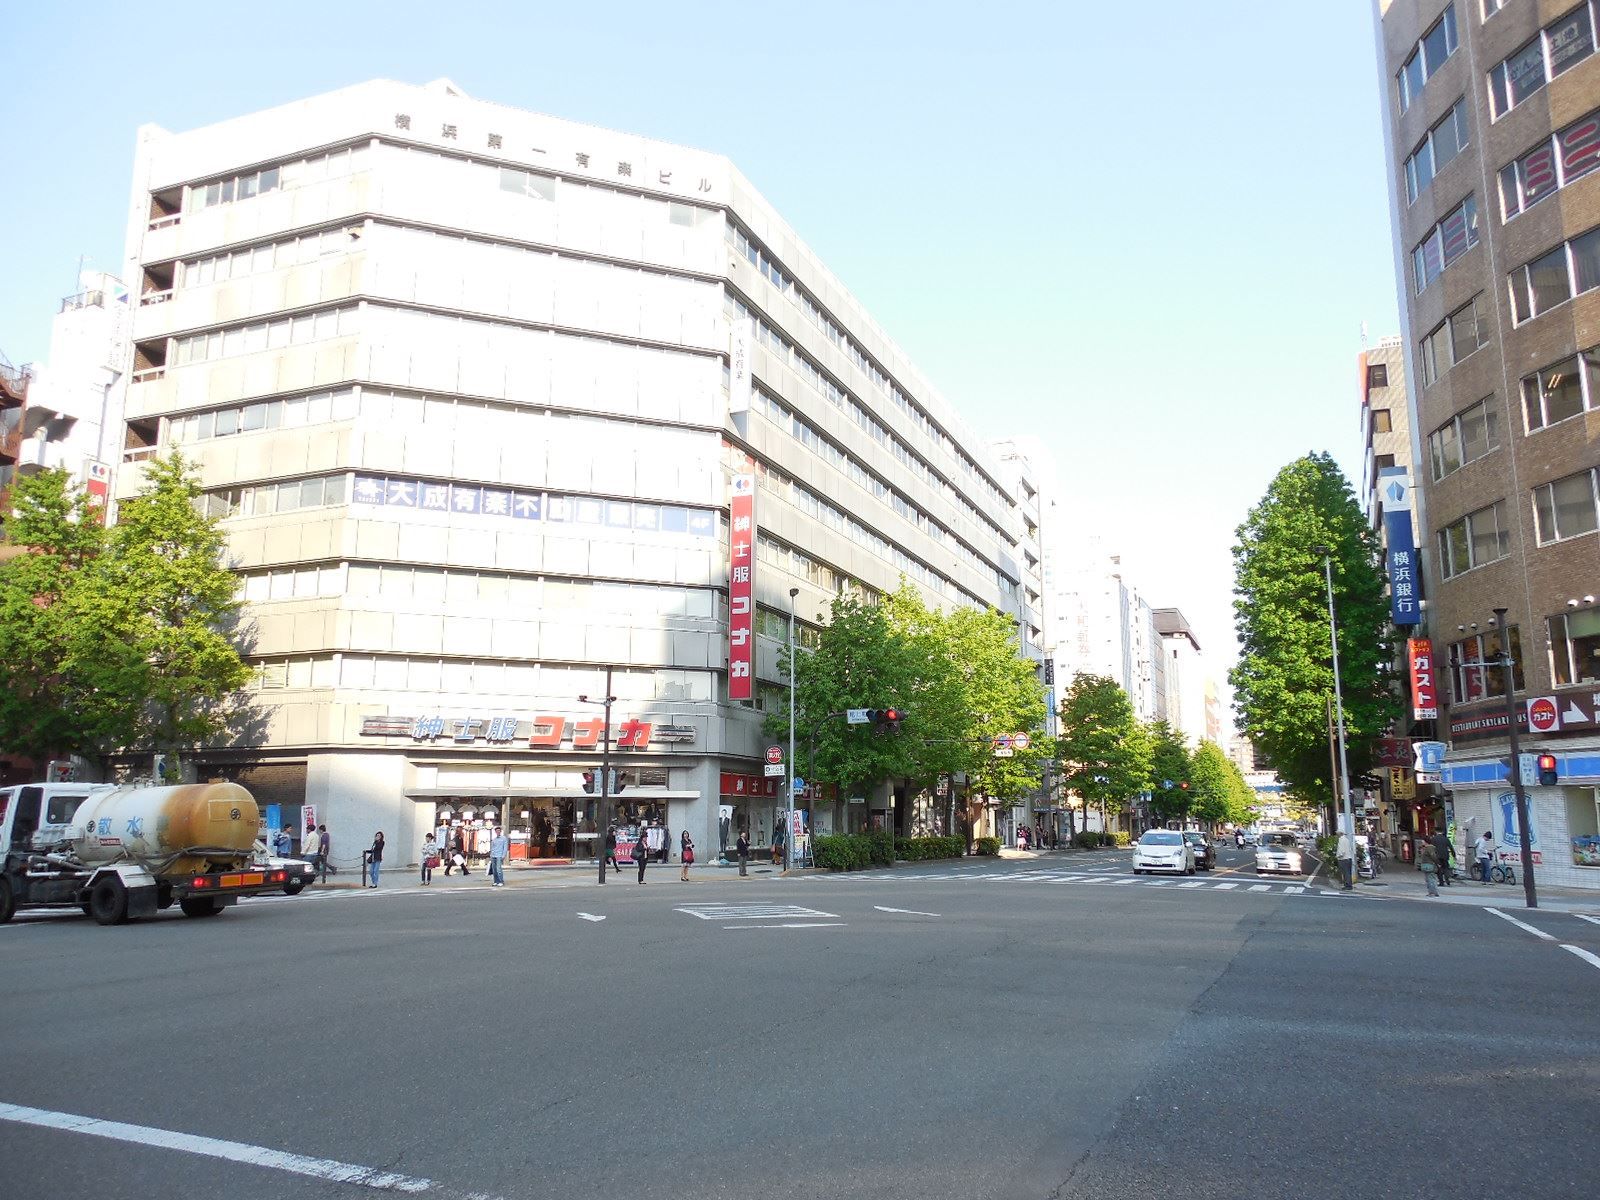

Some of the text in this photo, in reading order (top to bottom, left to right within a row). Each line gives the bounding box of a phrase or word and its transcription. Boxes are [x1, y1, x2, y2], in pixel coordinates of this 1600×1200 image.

[730, 515, 752, 678] 紳士服コナカ
[1393, 551, 1413, 613] 横浜銀行
[1413, 655, 1432, 706] ガスト
[1533, 711, 1554, 722] ガスト
